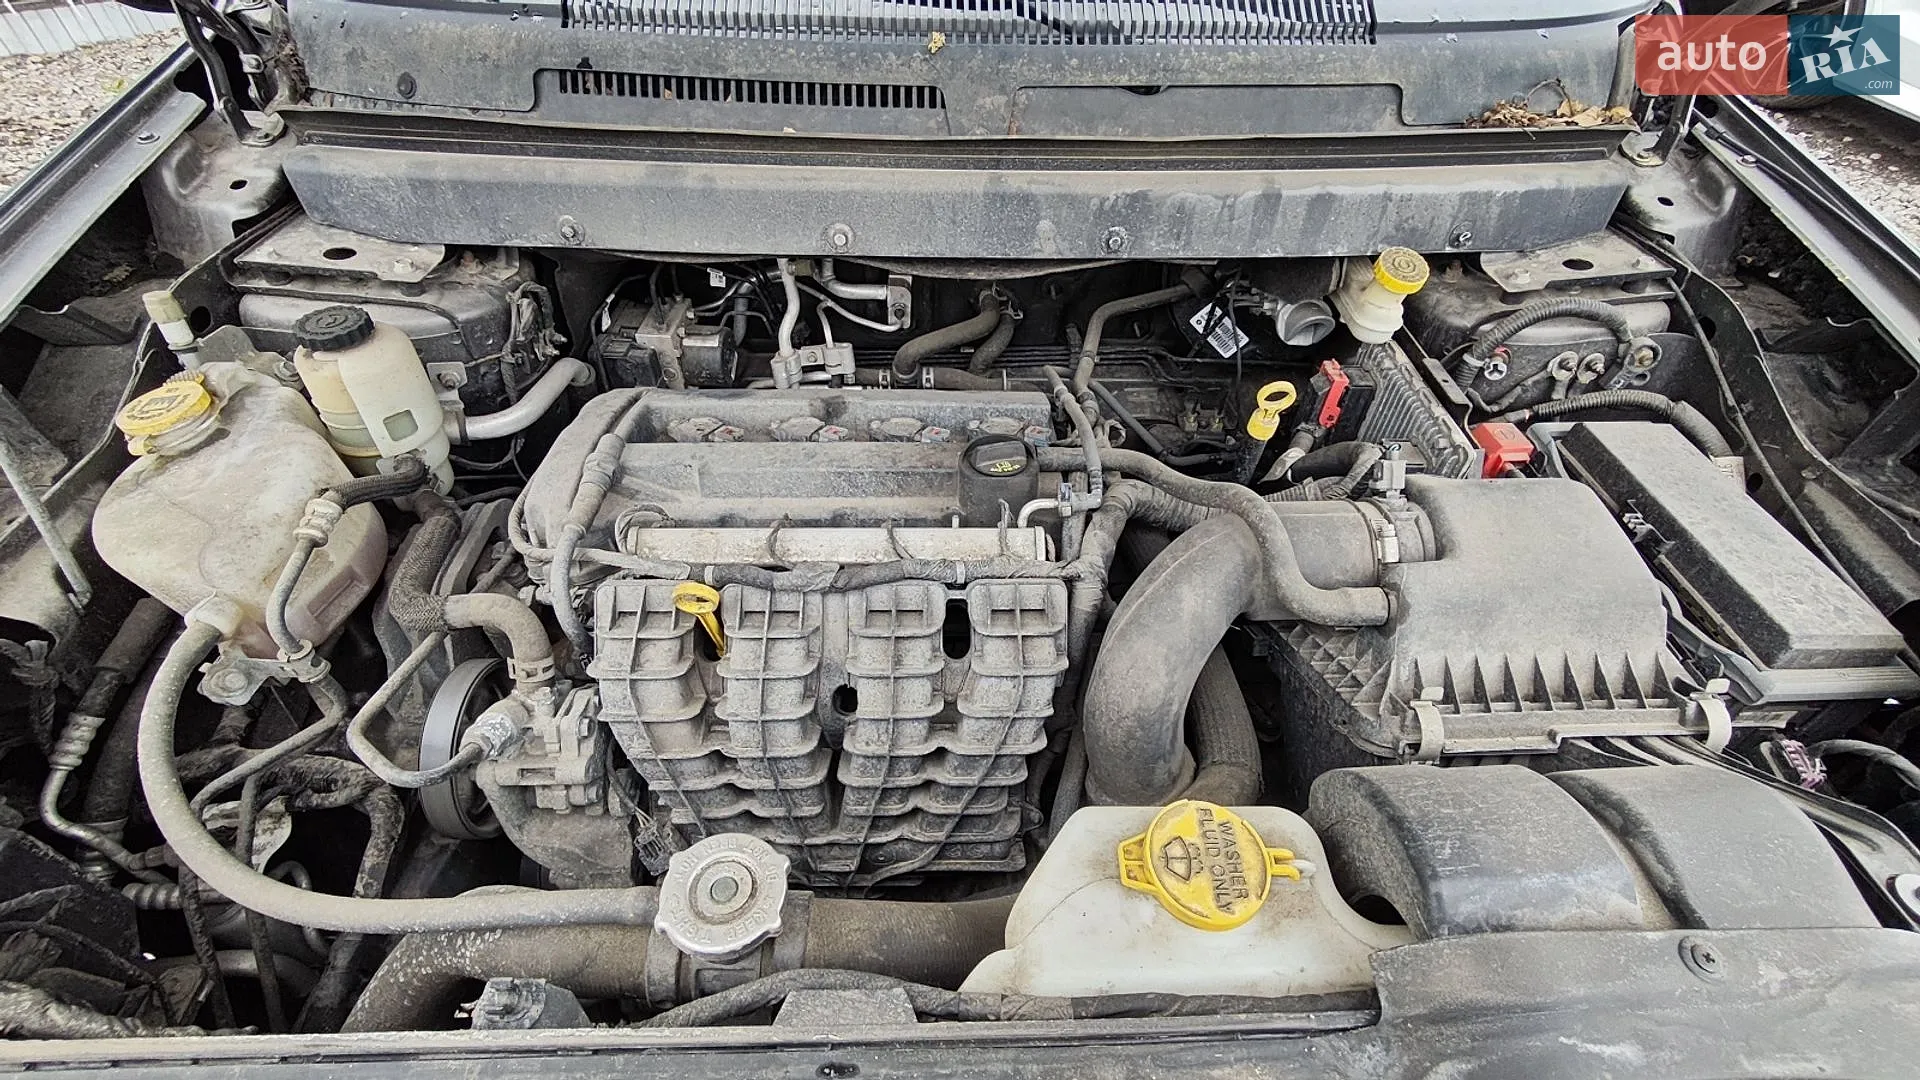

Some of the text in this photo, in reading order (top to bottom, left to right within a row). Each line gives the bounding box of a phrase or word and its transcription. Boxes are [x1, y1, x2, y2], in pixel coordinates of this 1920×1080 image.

[1197, 807, 1236, 915] FLUID ONLY
[1217, 820, 1250, 900] WASHER
